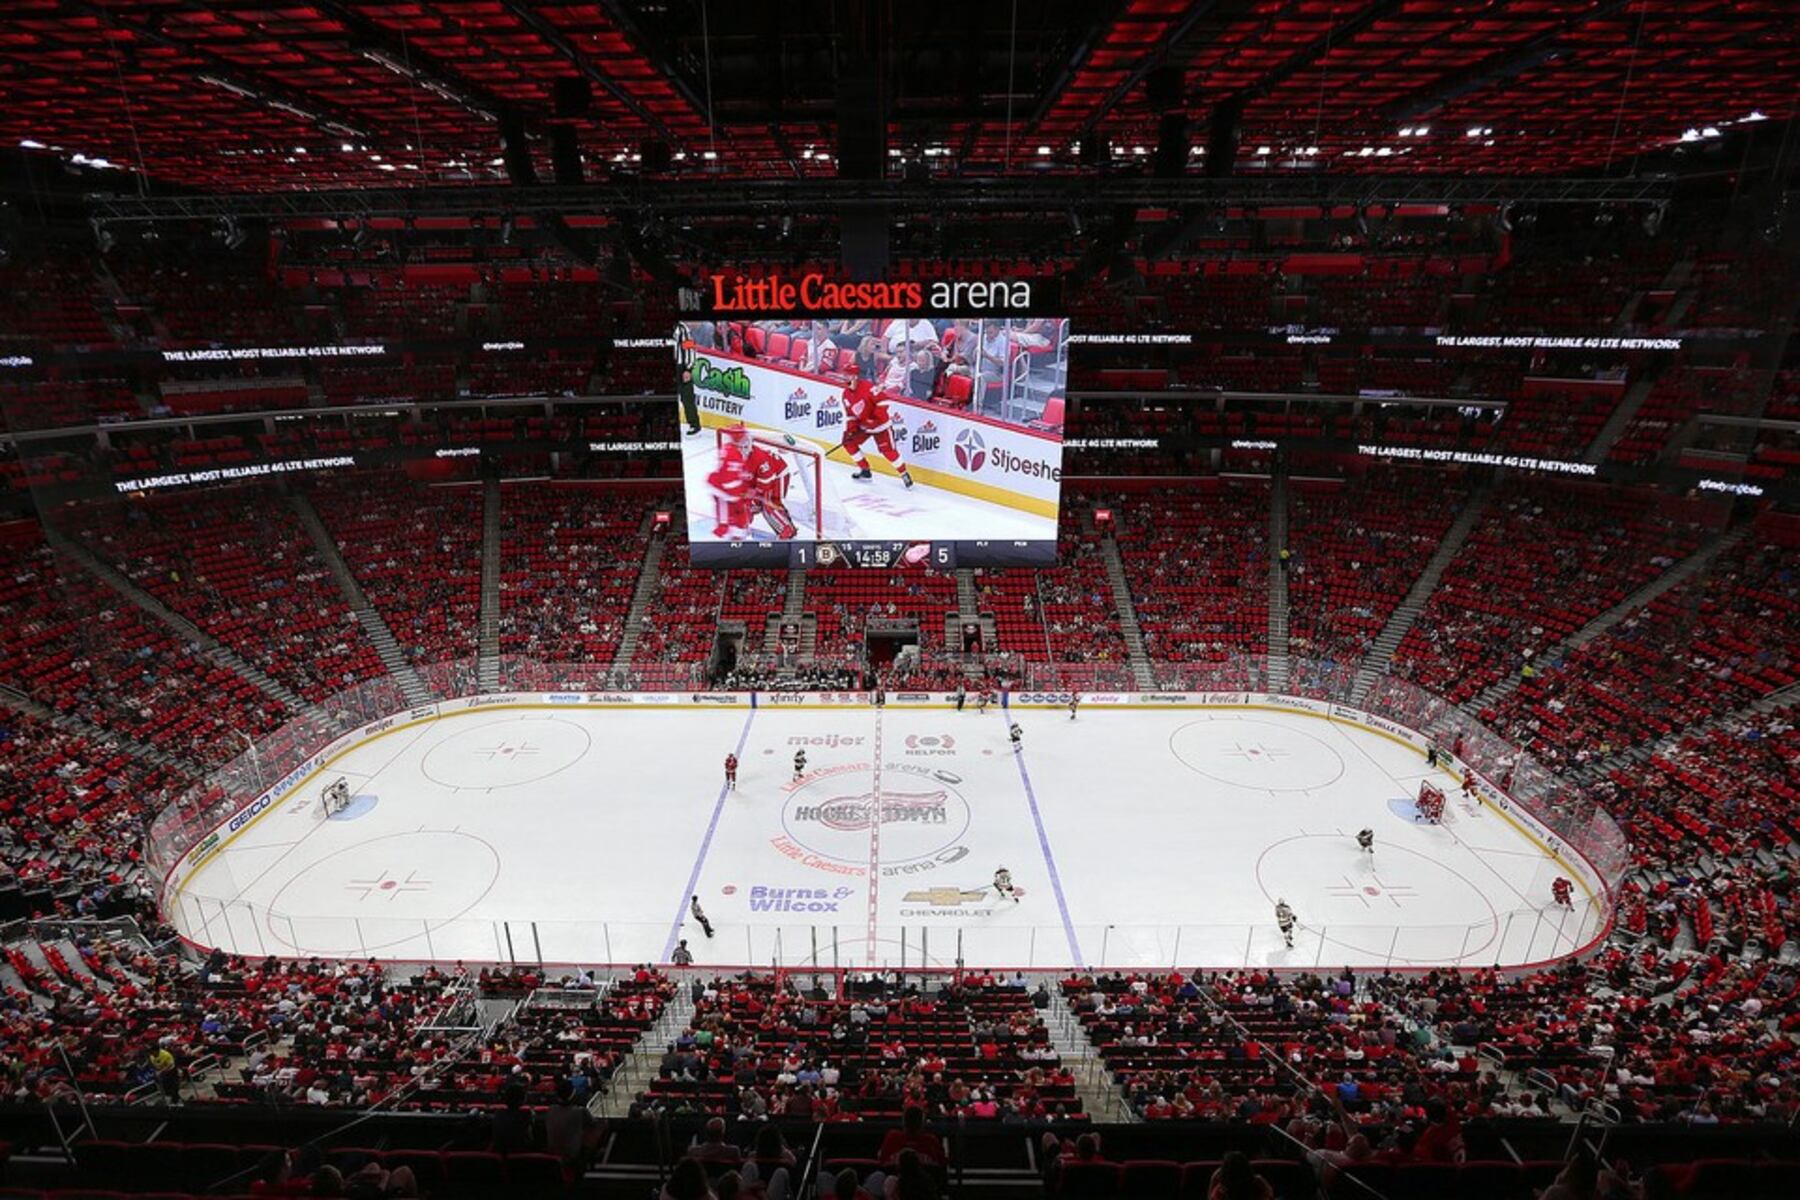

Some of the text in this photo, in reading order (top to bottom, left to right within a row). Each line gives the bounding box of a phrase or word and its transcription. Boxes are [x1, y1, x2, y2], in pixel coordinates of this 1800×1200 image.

[712, 274, 796, 310] Little
[799, 273, 923, 310] Caesars
[930, 280, 1030, 309] arena
[613, 338, 629, 348] THE
[1087, 334, 1125, 343] RELIABLE
[1125, 334, 1137, 343] 4G
[1137, 334, 1150, 344] LTE
[1151, 334, 1192, 344] NETWORK
[1436, 336, 1456, 346] THE
[1503, 338, 1532, 347] MOST
[1534, 338, 1582, 347] RELIABLE
[1583, 338, 1599, 347] 4G
[1600, 339, 1619, 348] LTE
[1620, 339, 1682, 349] NETWORK
[162, 351, 185, 361] THE
[231, 349, 259, 359] MOST
[261, 348, 307, 357] RELIABLE
[307, 347, 321, 356] 4G
[322, 346, 338, 355] LTE
[338, 345, 385, 355] NETWORK
[693, 357, 751, 400] Cash
[702, 398, 745, 416] LOTTERY
[785, 401, 811, 420] Blue
[816, 409, 843, 428] Blue
[590, 442, 608, 451] THE
[644, 442, 668, 451] MOST
[912, 433, 940, 453] Blue
[1100, 439, 1114, 448] LTE
[1115, 439, 1159, 448] NETWORK
[1358, 445, 1377, 455] THE
[1423, 450, 1453, 460] MOST
[1454, 452, 1502, 465] RELIABLE
[1503, 456, 1518, 466] 4G
[1518, 458, 1537, 468] LTE
[1537, 460, 1598, 475] NETWORK
[114, 481, 138, 492] THE
[189, 471, 220, 483] MOST
[222, 464, 270, 478] RELIABLE
[271, 463, 285, 473] 4G
[286, 461, 303, 471] LTE
[303, 456, 355, 469] NETWORK
[892, 543, 903, 551] 27
[798, 548, 806, 563] 1
[855, 551, 890, 562] 14:58
[938, 549, 948, 563] 5
[787, 734, 865, 748] meijer
[884, 762, 930, 774] arena
[229, 794, 271, 832] GEICO
[770, 835, 936, 877] Little Caesars arena
[750, 885, 855, 899] Burns &
[749, 899, 838, 912] Wilcox
[899, 909, 994, 917] CHEVROLET
